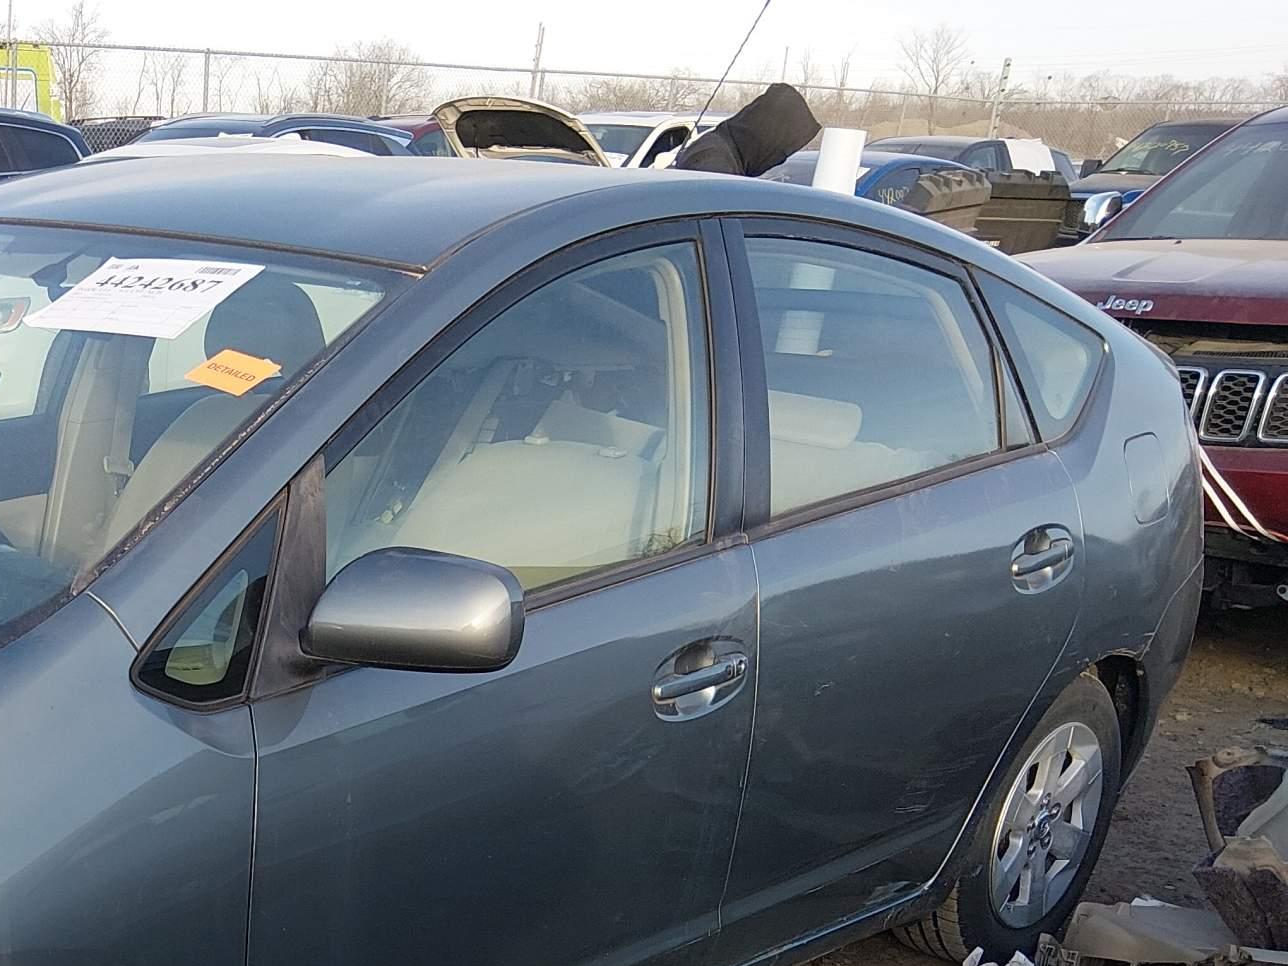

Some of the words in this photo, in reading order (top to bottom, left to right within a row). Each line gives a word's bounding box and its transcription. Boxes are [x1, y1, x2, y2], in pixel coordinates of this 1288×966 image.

[95, 275, 223, 293] 44242687
[1097, 295, 1154, 315] Jeep
[207, 363, 256, 381] DETAILED
